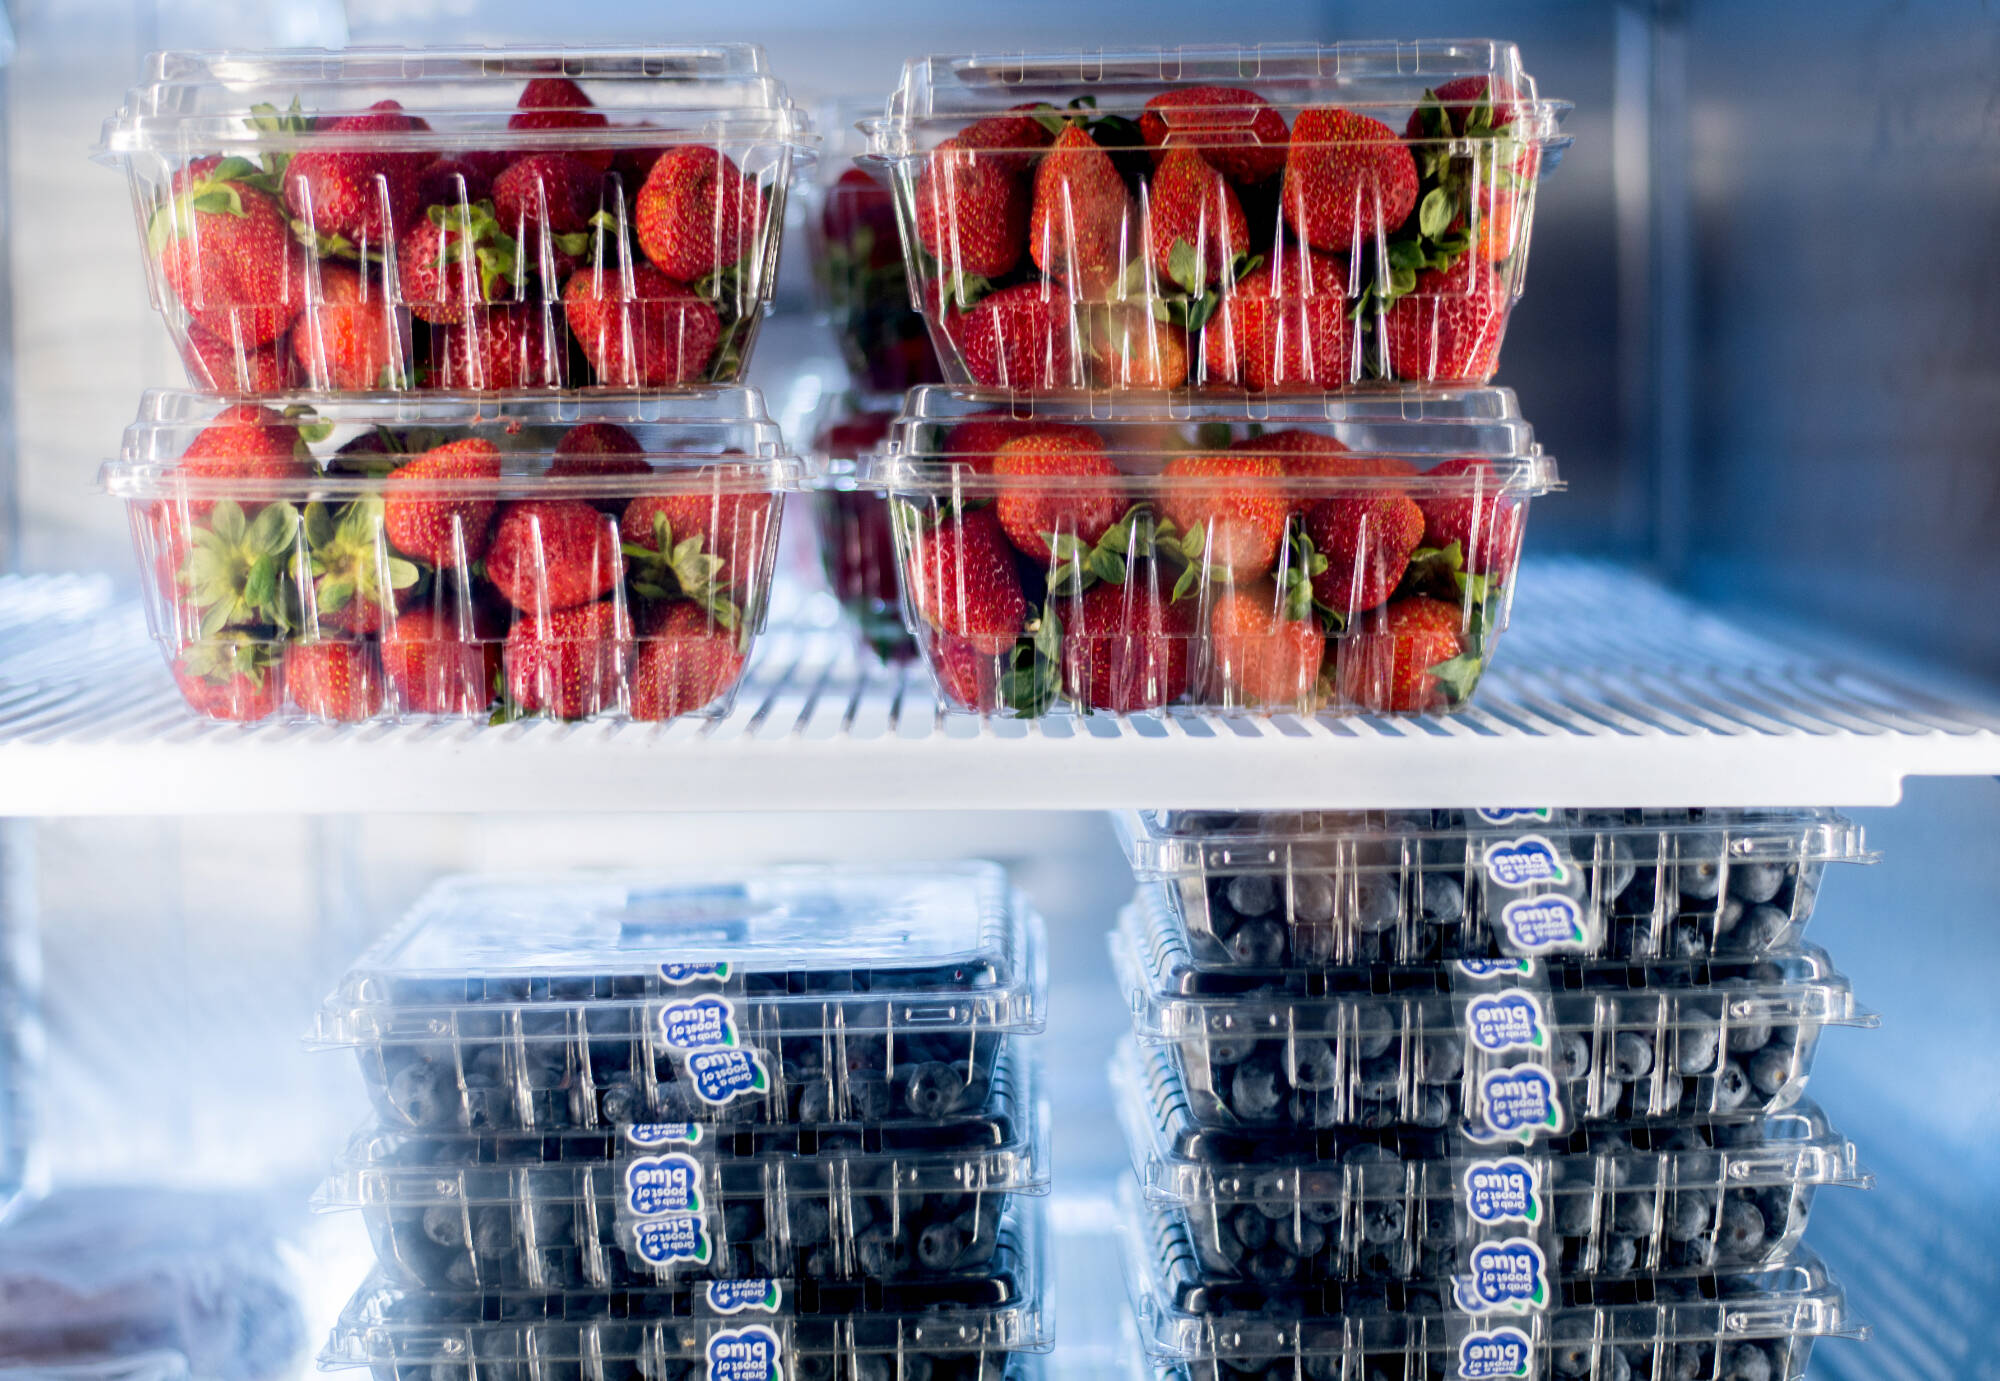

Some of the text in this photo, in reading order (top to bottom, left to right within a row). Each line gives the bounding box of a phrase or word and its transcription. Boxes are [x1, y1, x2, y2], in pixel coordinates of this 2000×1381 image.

[1494, 853, 1546, 866] blue
[1513, 906, 1566, 922] blue
[669, 1007, 720, 1022] blue
[1476, 1006, 1528, 1024] blue
[672, 1021, 720, 1035] boost of
[1480, 1023, 1529, 1034] boost of
[1507, 1030, 1531, 1038] Grab
[698, 1031, 722, 1041] Grab
[695, 1051, 746, 1070] blue
[702, 1063, 750, 1084] boost of
[719, 1072, 752, 1087] Grab a
[1490, 1080, 1542, 1099] blue
[1494, 1099, 1543, 1112] boost of
[1520, 1108, 1544, 1116] Grab
[636, 1168, 686, 1186] blue
[1474, 1174, 1524, 1192] blue
[638, 1187, 687, 1200] boost of
[1476, 1190, 1524, 1202] boost of
[663, 1196, 687, 1205] Grab
[1501, 1200, 1525, 1208] Grab
[643, 1218, 693, 1232] blue
[646, 1232, 694, 1244] boost of
[663, 1240, 695, 1250] Grab a
[1480, 1255, 1531, 1273] blue
[1483, 1271, 1531, 1283] boost of
[717, 1280, 765, 1291] boost of
[1508, 1283, 1532, 1291] Grab
[716, 1342, 767, 1361] blue
[1469, 1344, 1518, 1361] blue
[718, 1361, 767, 1372] boost of
[1469, 1360, 1516, 1370] boost of
[734, 1372, 767, 1381] Grab a
